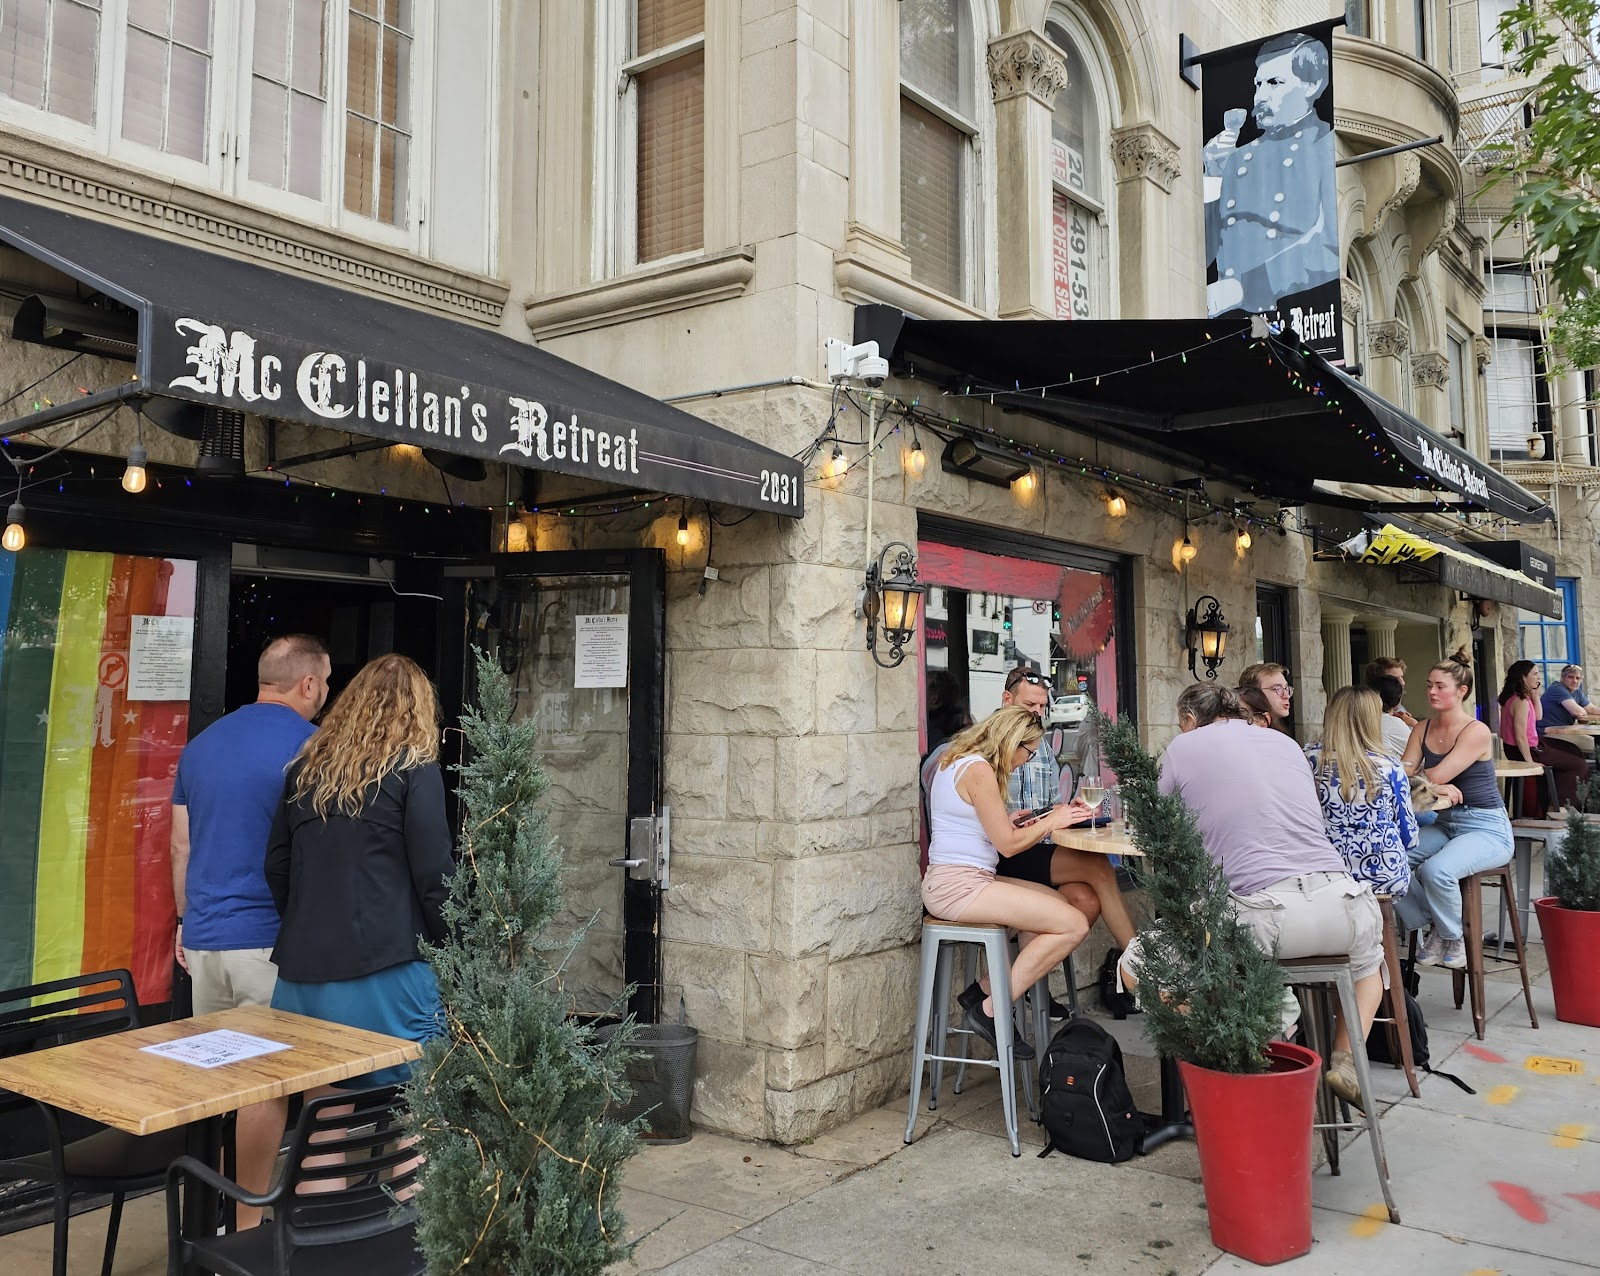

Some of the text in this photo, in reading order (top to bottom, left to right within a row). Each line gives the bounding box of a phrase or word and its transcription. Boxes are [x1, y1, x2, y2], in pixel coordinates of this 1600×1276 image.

[1053, 223, 1069, 286] OFFICE
[1068, 151, 1090, 320] 20-491-53
[1055, 285, 1072, 320] SPA
[1289, 303, 1337, 343] Retreat
[168, 317, 798, 507] Mc Clellan's Retreat 2031
[1461, 463, 1491, 500] Retreat
